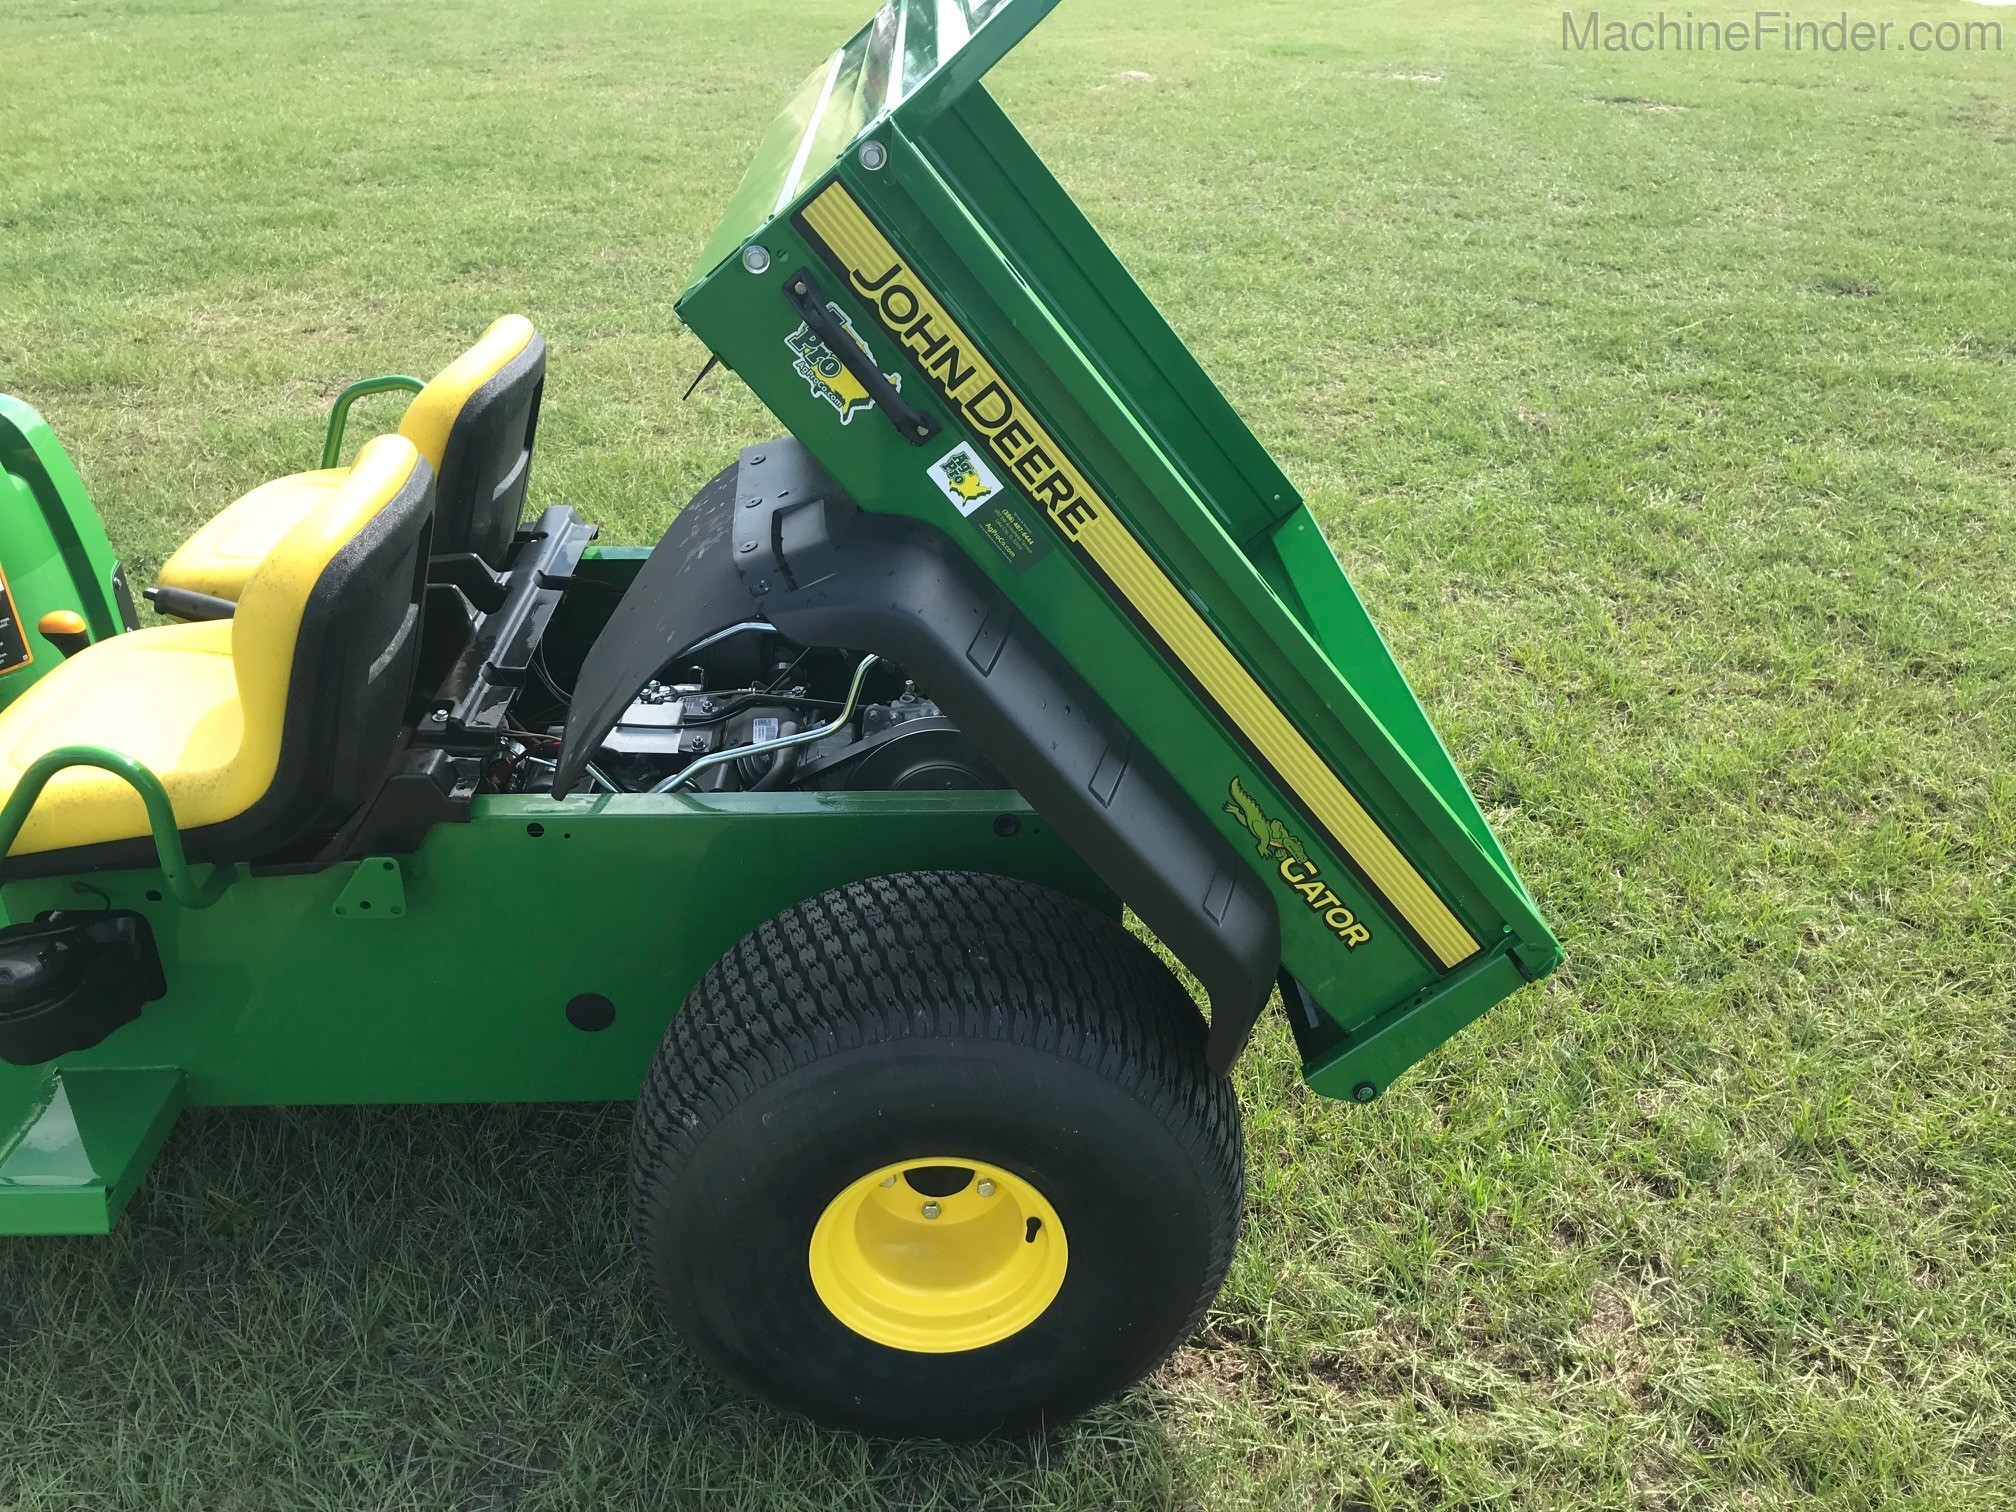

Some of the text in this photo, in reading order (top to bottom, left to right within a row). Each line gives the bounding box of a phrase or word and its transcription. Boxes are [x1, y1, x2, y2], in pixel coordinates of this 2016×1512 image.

[787, 325, 842, 378] Pro
[797, 361, 843, 409] AgProCo.com
[851, 262, 1098, 536] JOHN DEERE
[941, 459, 965, 485] Pro
[984, 523, 1016, 558] AgProCo.com
[1278, 857, 1371, 950] GATOR
